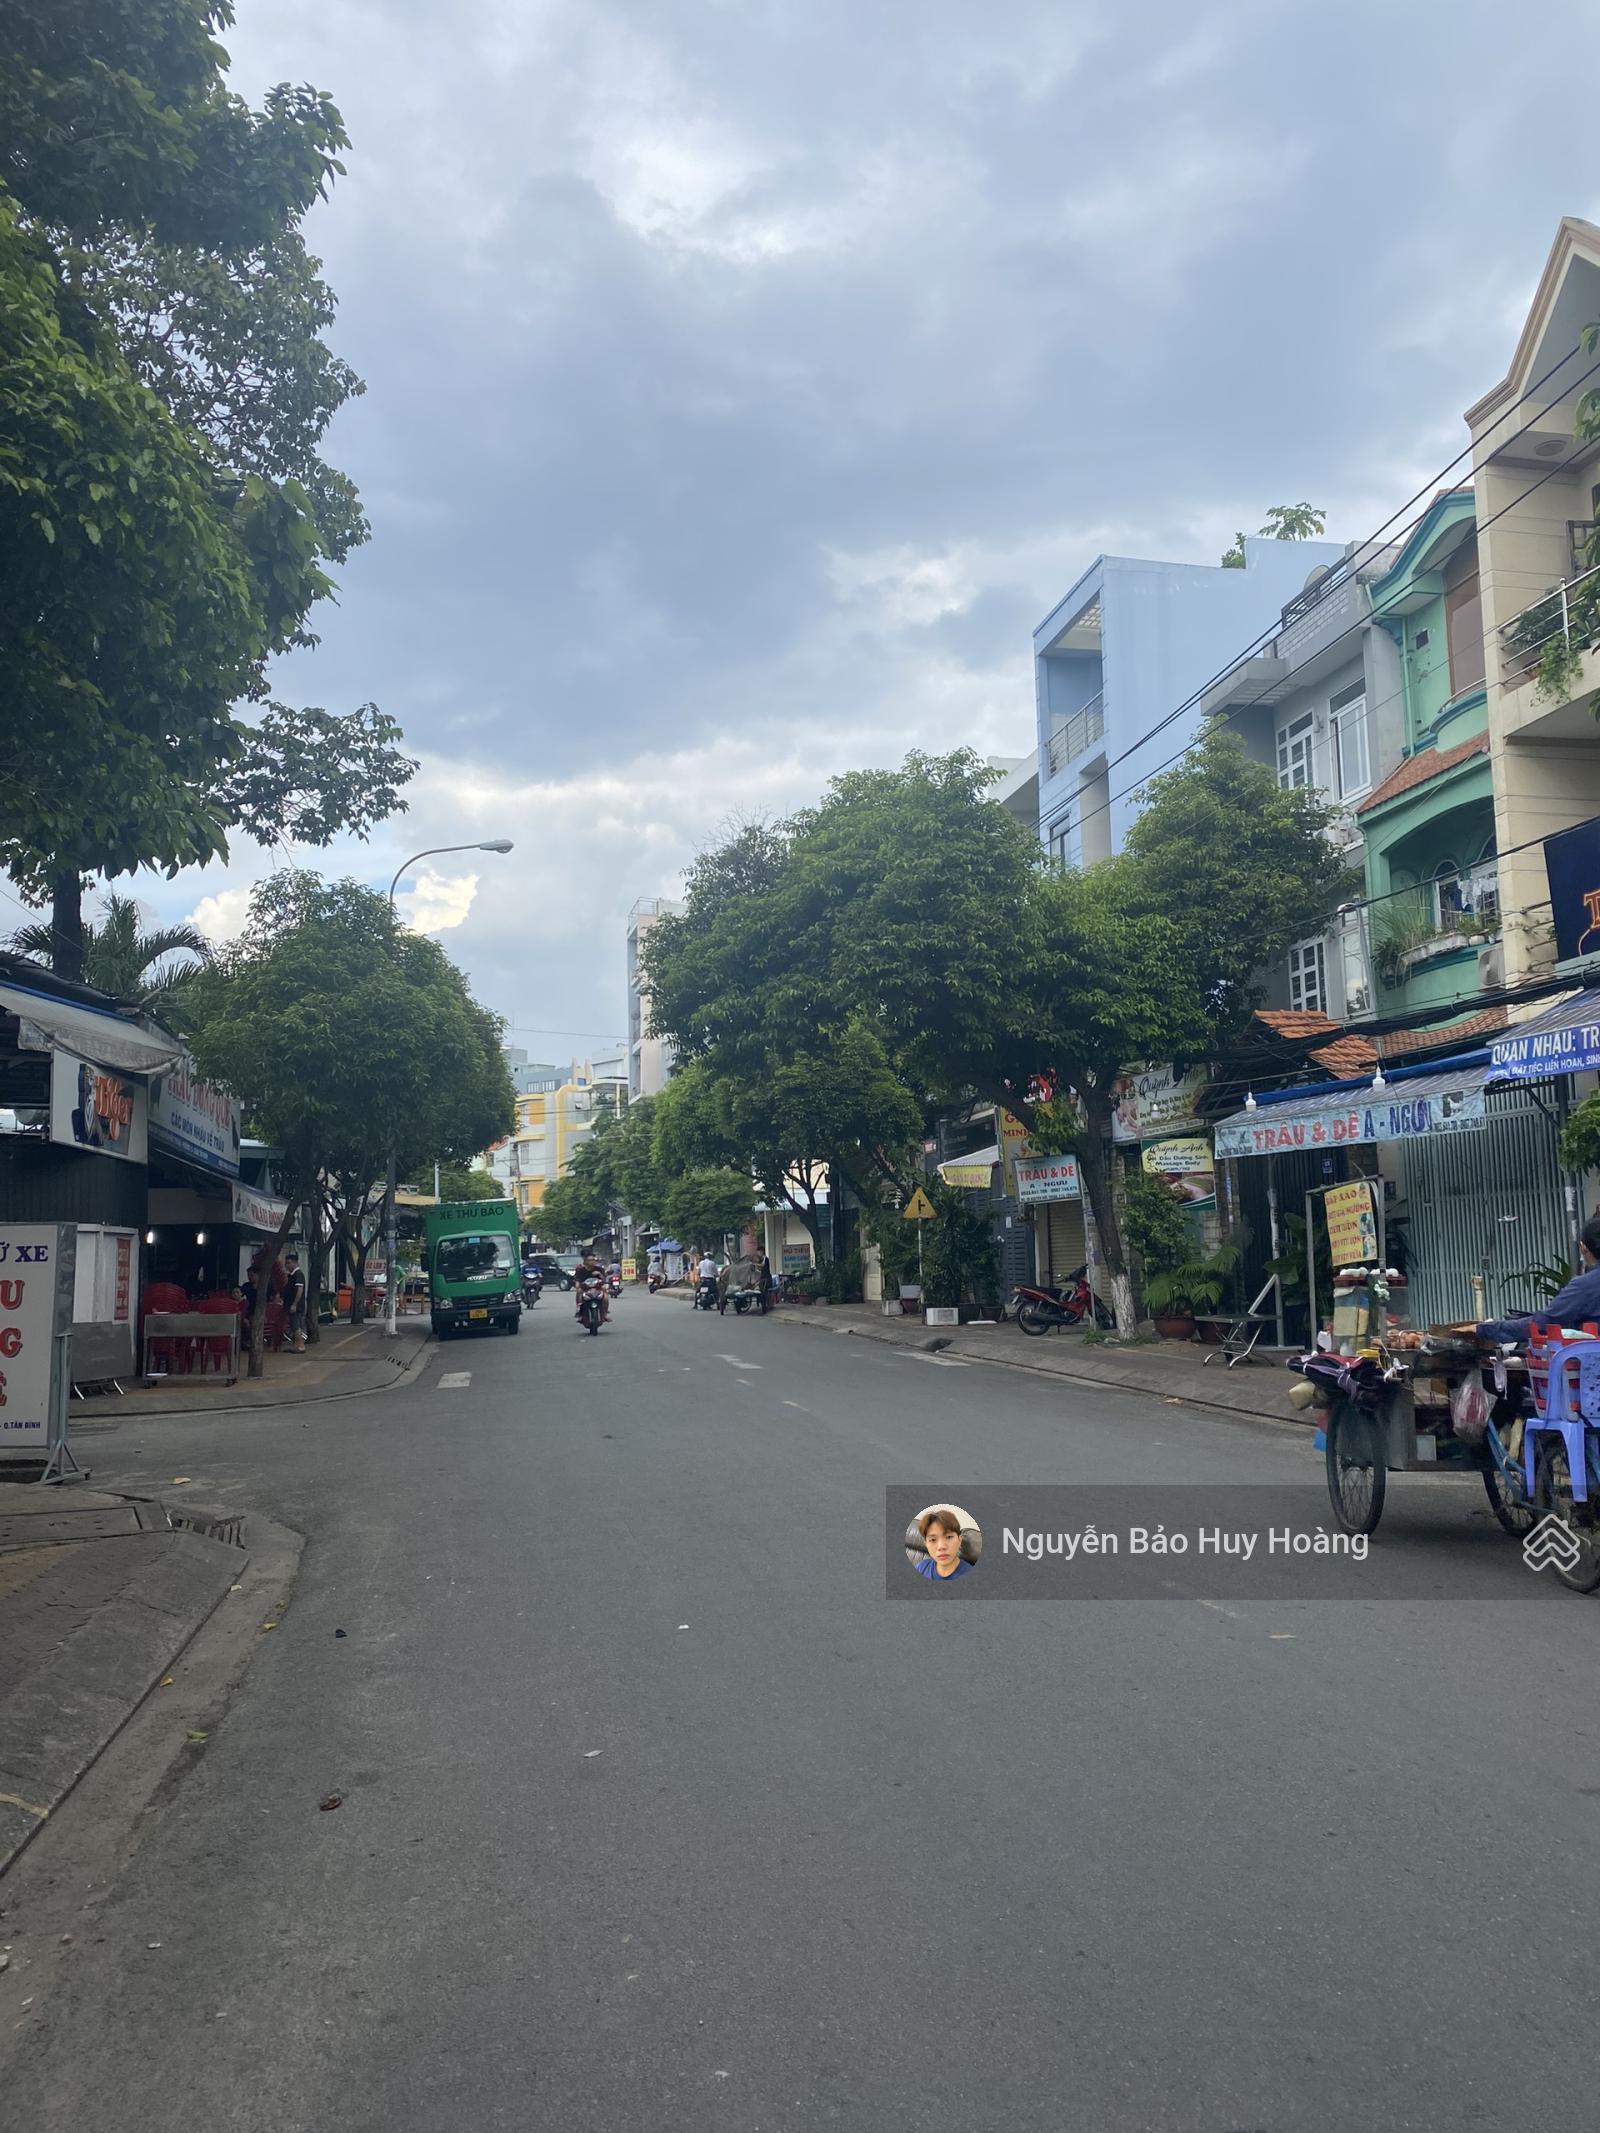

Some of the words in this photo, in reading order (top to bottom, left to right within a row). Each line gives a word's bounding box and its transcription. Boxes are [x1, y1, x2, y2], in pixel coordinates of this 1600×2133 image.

[1253, 1120, 1305, 1151] TRÂU
[1312, 1120, 1327, 1143] &
[1333, 1110, 1360, 1141] DÊ
[1364, 1109, 1375, 1138] A
[1018, 1165, 1048, 1182] TRÂU
[1051, 1167, 1058, 1179] &
[1060, 1162, 1075, 1178] DÊ
[15, 1245, 49, 1263] XE
